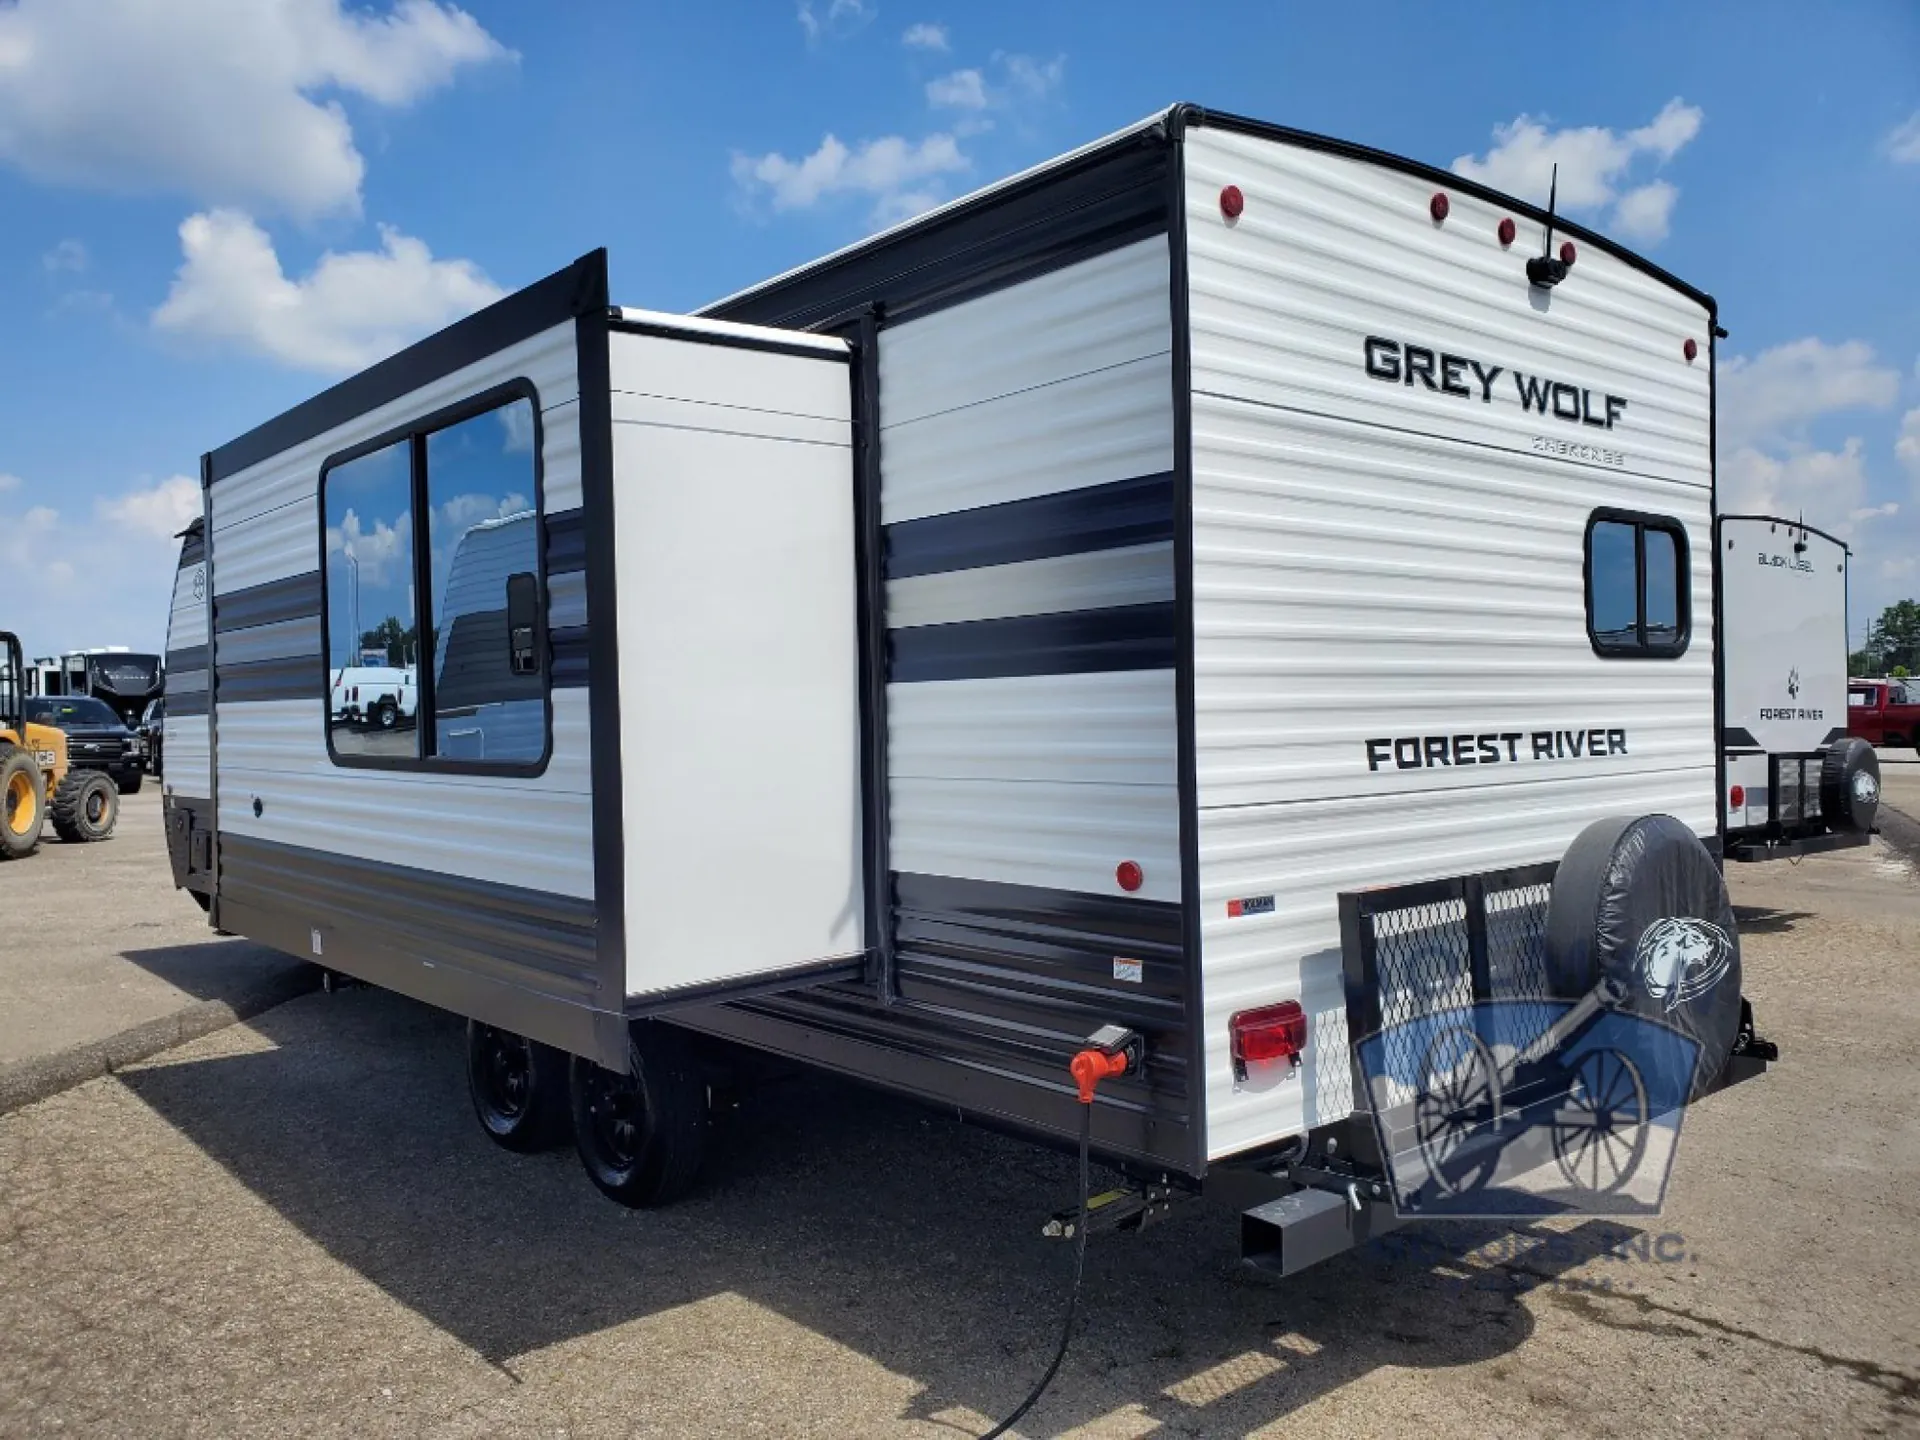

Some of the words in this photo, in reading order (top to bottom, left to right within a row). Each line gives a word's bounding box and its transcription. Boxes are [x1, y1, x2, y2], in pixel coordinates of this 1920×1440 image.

[1364, 335, 1503, 403] GREY
[1513, 371, 1627, 430] WOLF
[1758, 552, 1788, 568] BLACK
[1760, 707, 1796, 720] FOREST
[1797, 707, 1823, 721] RIVER
[1365, 732, 1523, 771] FOREST
[1531, 728, 1628, 760] RIVER
